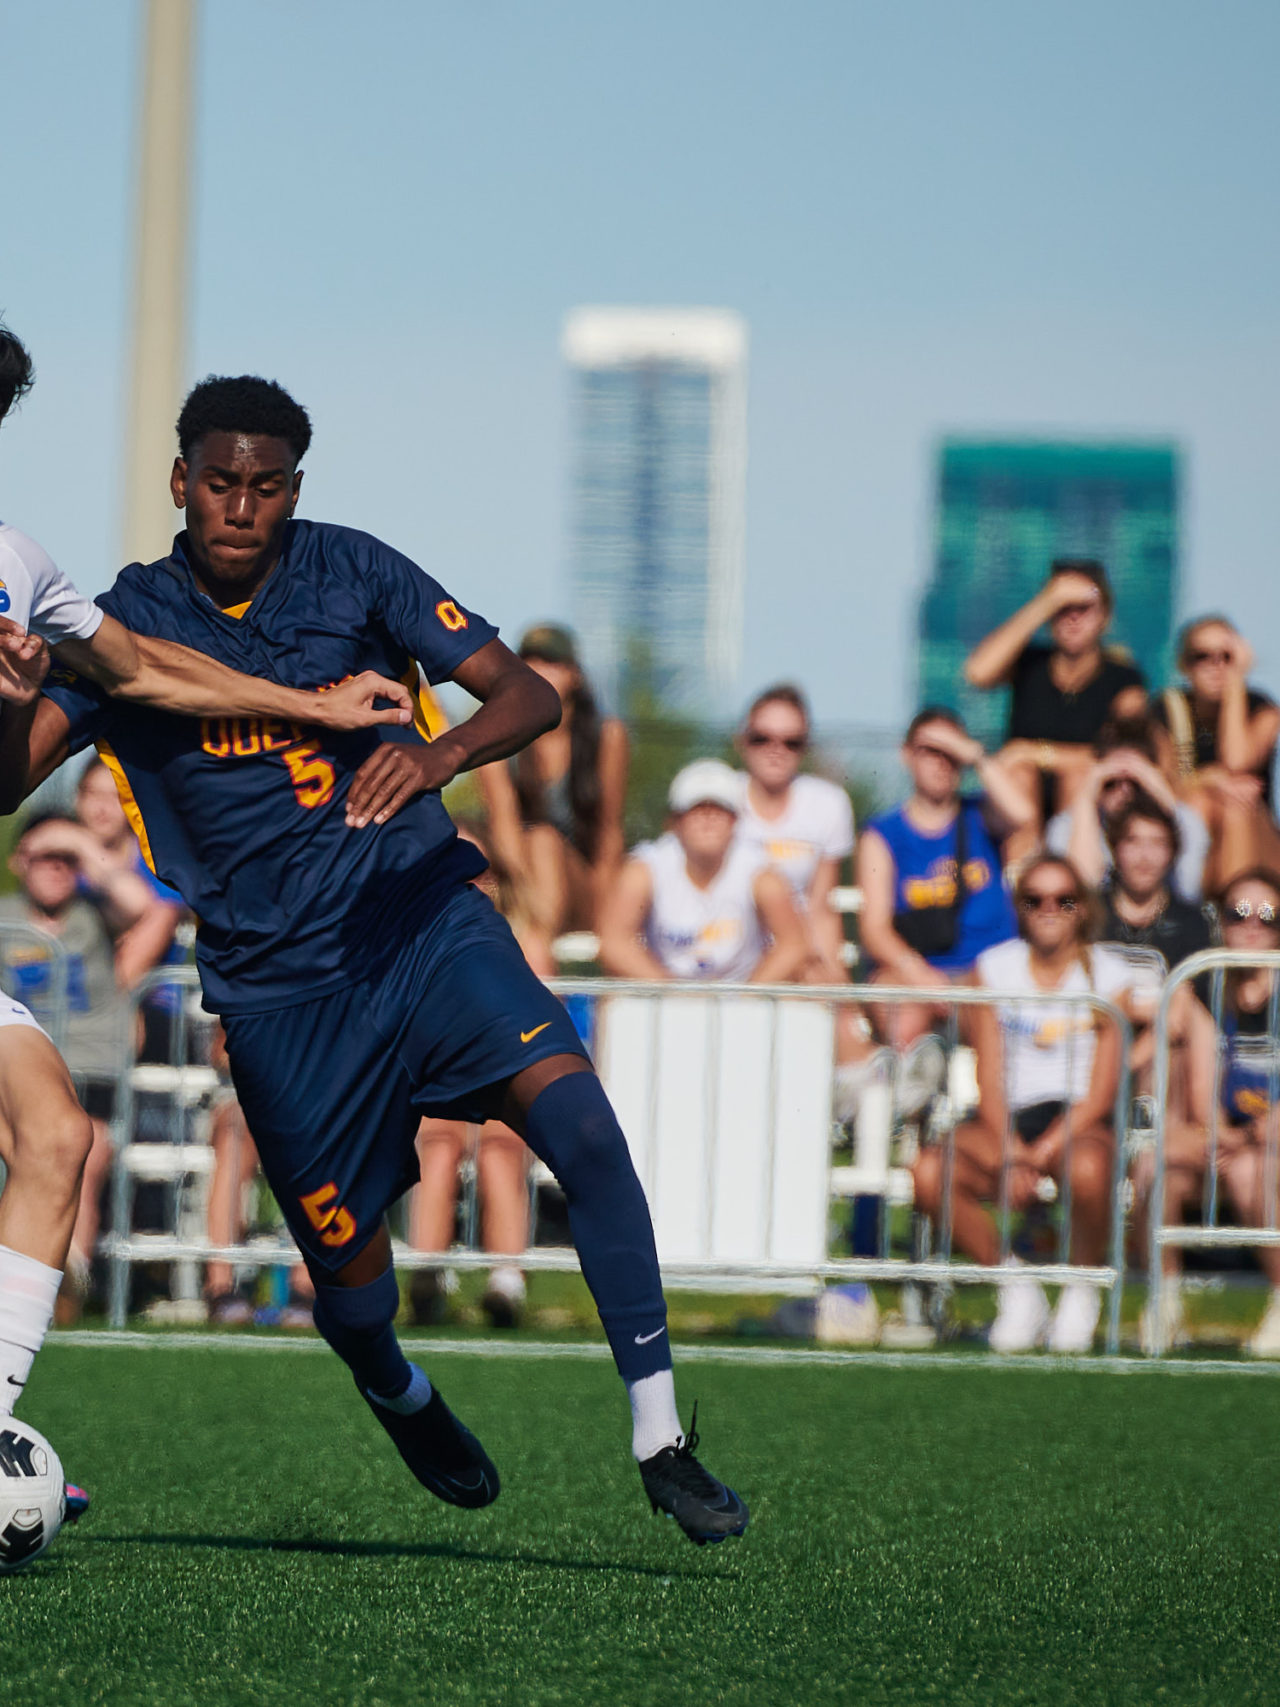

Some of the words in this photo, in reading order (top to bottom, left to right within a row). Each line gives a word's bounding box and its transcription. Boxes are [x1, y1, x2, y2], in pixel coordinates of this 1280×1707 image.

[435, 600, 468, 632] Q
[280, 738, 336, 809] 5
[298, 1180, 357, 1247] 5
